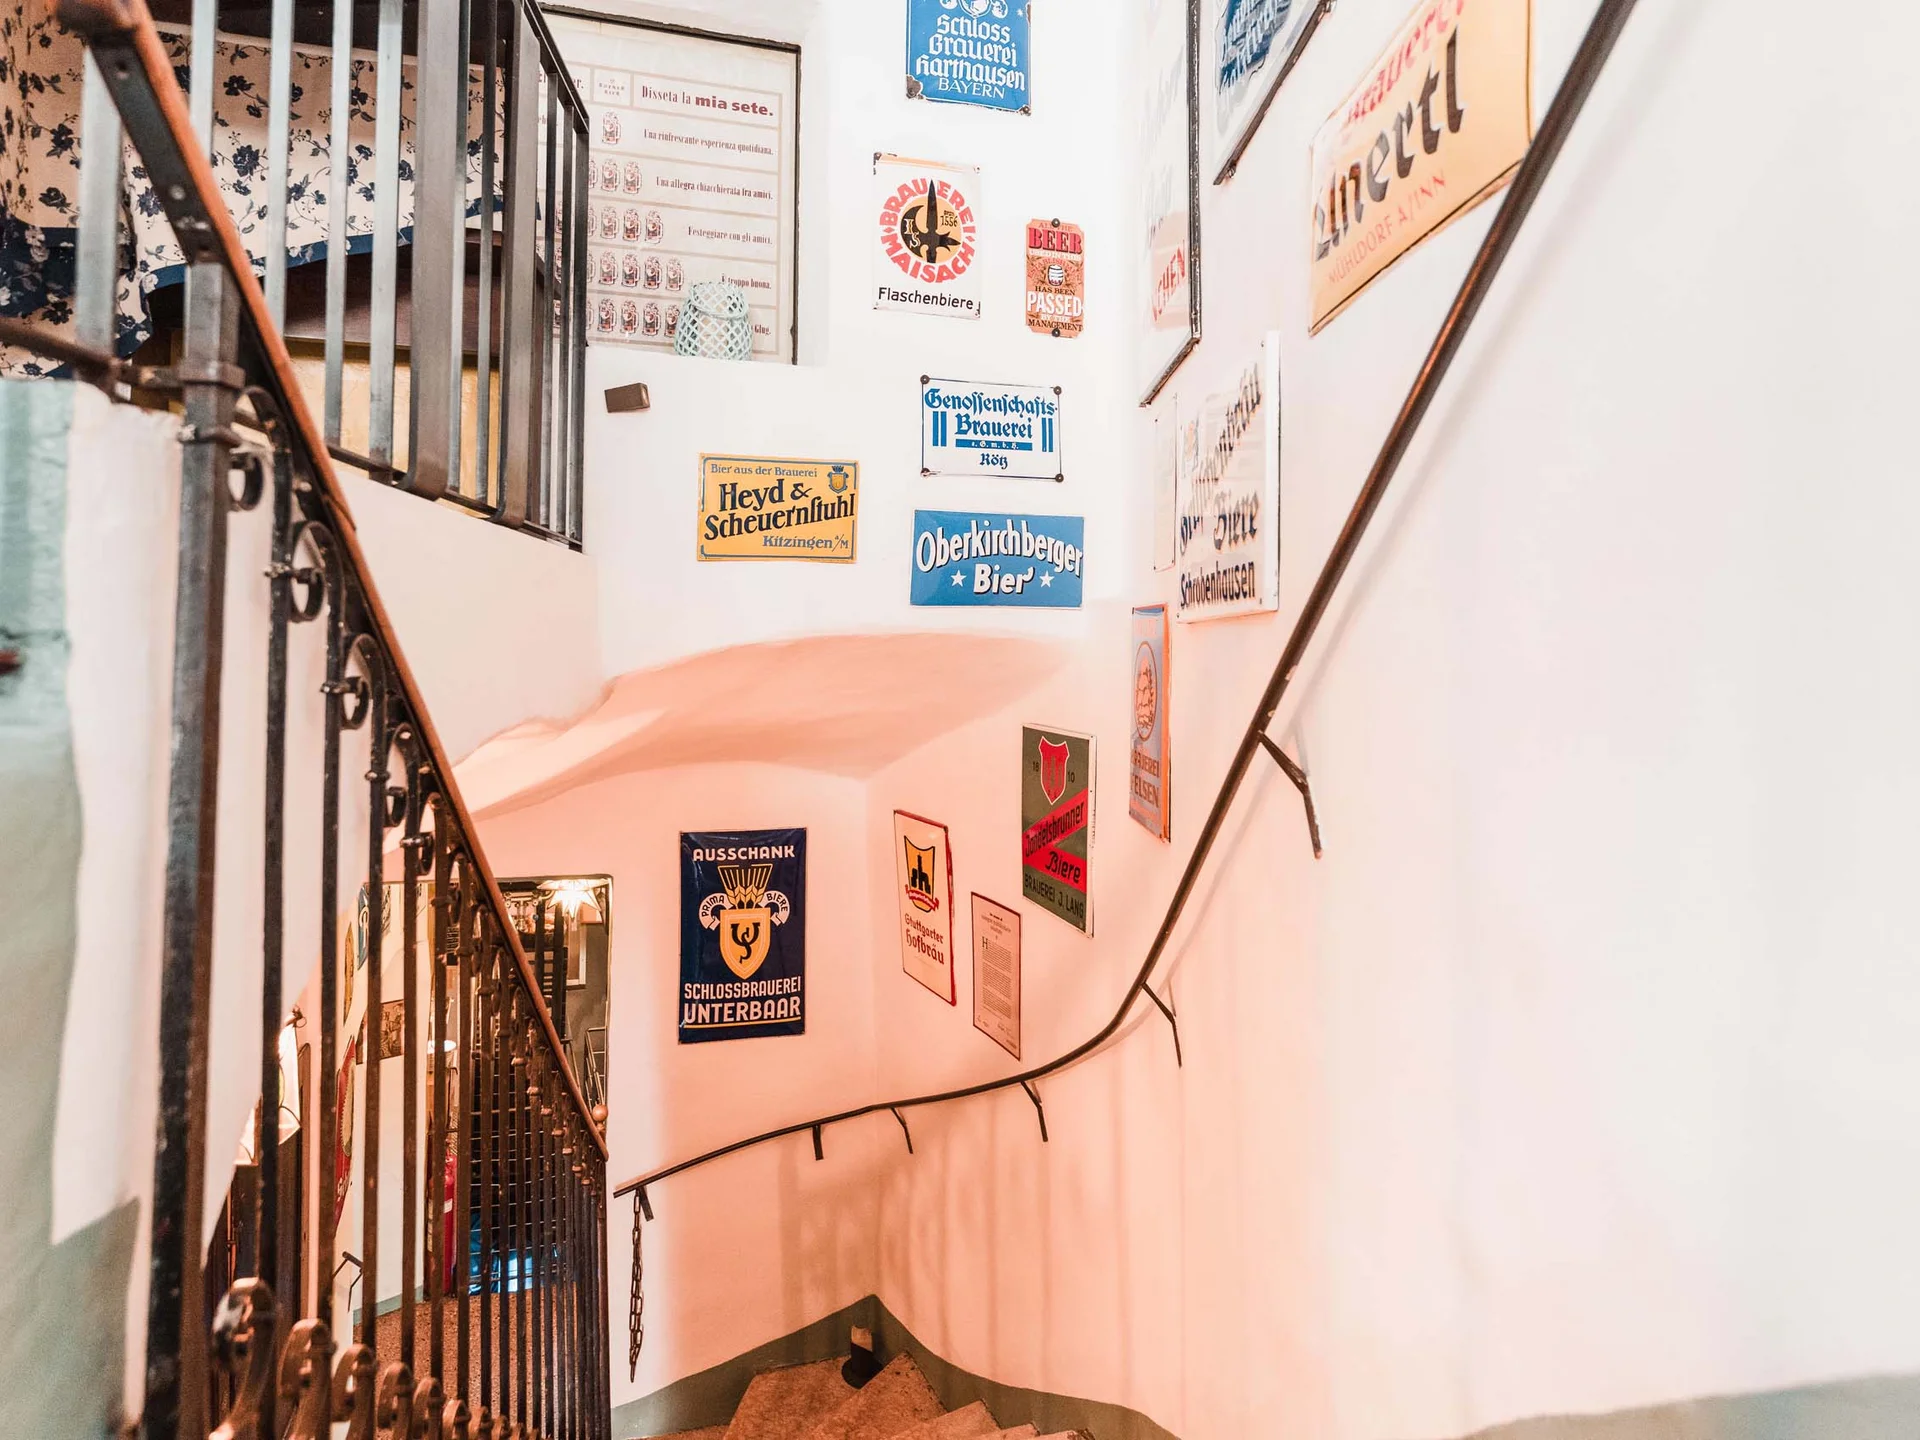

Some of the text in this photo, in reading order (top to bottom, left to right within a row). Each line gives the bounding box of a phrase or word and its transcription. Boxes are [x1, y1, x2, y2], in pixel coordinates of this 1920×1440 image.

[928, 33, 1017, 67] Brauerei
[642, 85, 774, 117] Disseta la mia sete.
[938, 77, 1006, 100] BAYERN
[658, 131, 700, 145] rinfrescante
[700, 138, 736, 150] esperienza
[737, 144, 774, 156] quotidiana.
[670, 178, 695, 190] allegra
[697, 182, 741, 196] chiacchierata
[741, 187, 752, 197] fra
[752, 189, 774, 200] amici.
[879, 178, 976, 234] BRAUEREI
[940, 215, 958, 227] 1556
[688, 225, 773, 245] Festeggiare con gli amici.
[1028, 227, 1083, 255] BEER
[880, 234, 976, 283] MAISACH
[1328, 215, 1394, 284] MÜHLDORF
[751, 278, 772, 289] buona.
[1035, 286, 1076, 296] HAS BEEN
[878, 287, 974, 310] Flaschenbiere
[1027, 291, 1082, 317] PASSED
[1028, 319, 1083, 332] MANAGEMENT
[954, 413, 1032, 439] Brauerei
[711, 463, 818, 478] Bier aus der Brauerei
[718, 478, 813, 512] Heyd &
[762, 535, 833, 551] Kitzingen
[916, 519, 1083, 578] Oberkirchberger
[973, 563, 1035, 595] Bier
[1180, 561, 1256, 610] Schrobenhausen
[1068, 771, 1075, 783] 10
[1025, 801, 1085, 858] Jandelsbrunner
[692, 845, 795, 862] AUSSCHANK
[1045, 851, 1081, 884] Biere
[701, 893, 788, 917] PRIMA BIERE
[1025, 874, 1055, 902] BRAUEREI
[1065, 895, 1084, 920] LANG
[904, 913, 944, 944] Stuttgarter
[906, 928, 945, 965] Hofbräu
[683, 975, 801, 1000] SCHLOSSBRAUEREI
[683, 996, 801, 1024] UNTERBAAR
